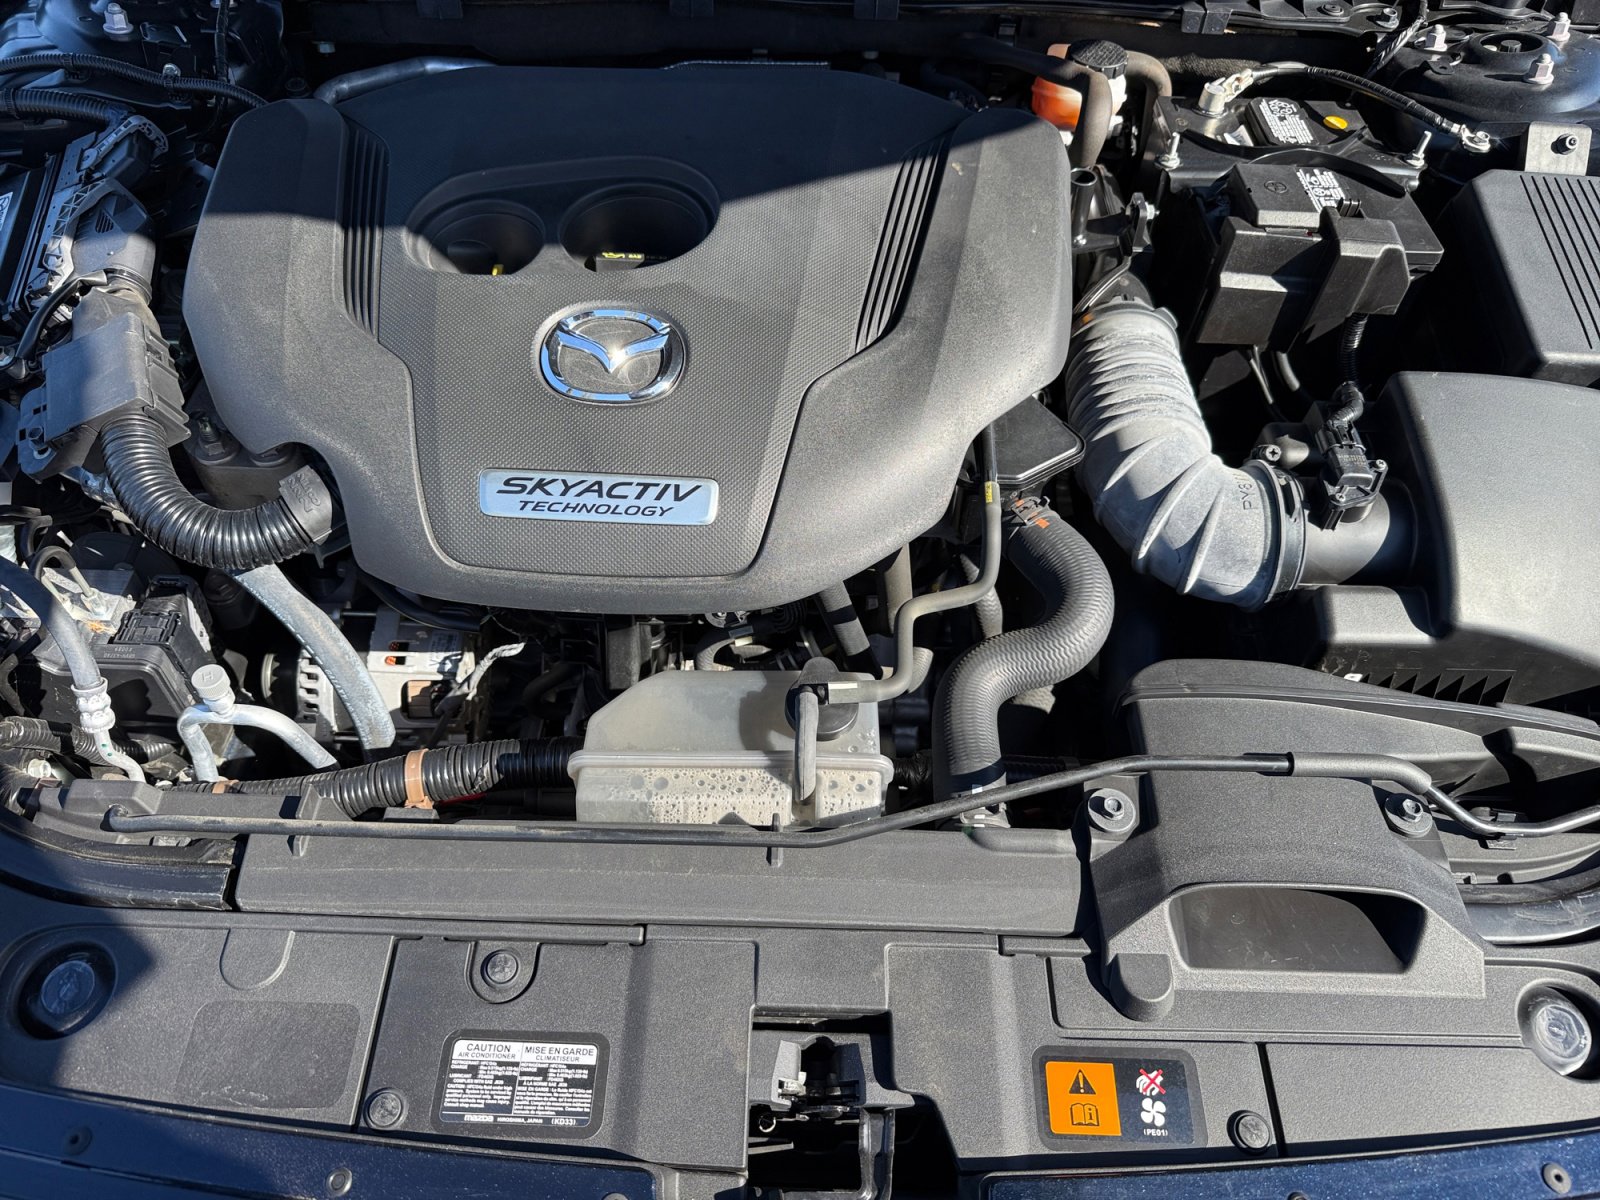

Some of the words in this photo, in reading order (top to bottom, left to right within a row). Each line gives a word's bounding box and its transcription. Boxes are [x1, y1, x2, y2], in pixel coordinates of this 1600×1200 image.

[496, 476, 702, 502] SKYACTIV
[519, 500, 674, 517] TECHNOLOGY
[466, 1043, 511, 1053] CAUTION
[524, 1046, 546, 1055] MISE
[549, 1047, 562, 1055] EN
[562, 1048, 594, 1057] GARDE
[471, 1052, 516, 1060] CONDITIONER
[535, 1055, 580, 1063] CLIMATISEUR
[464, 1114, 494, 1122] mazda
[1143, 1128, 1168, 1136] (PE01)
